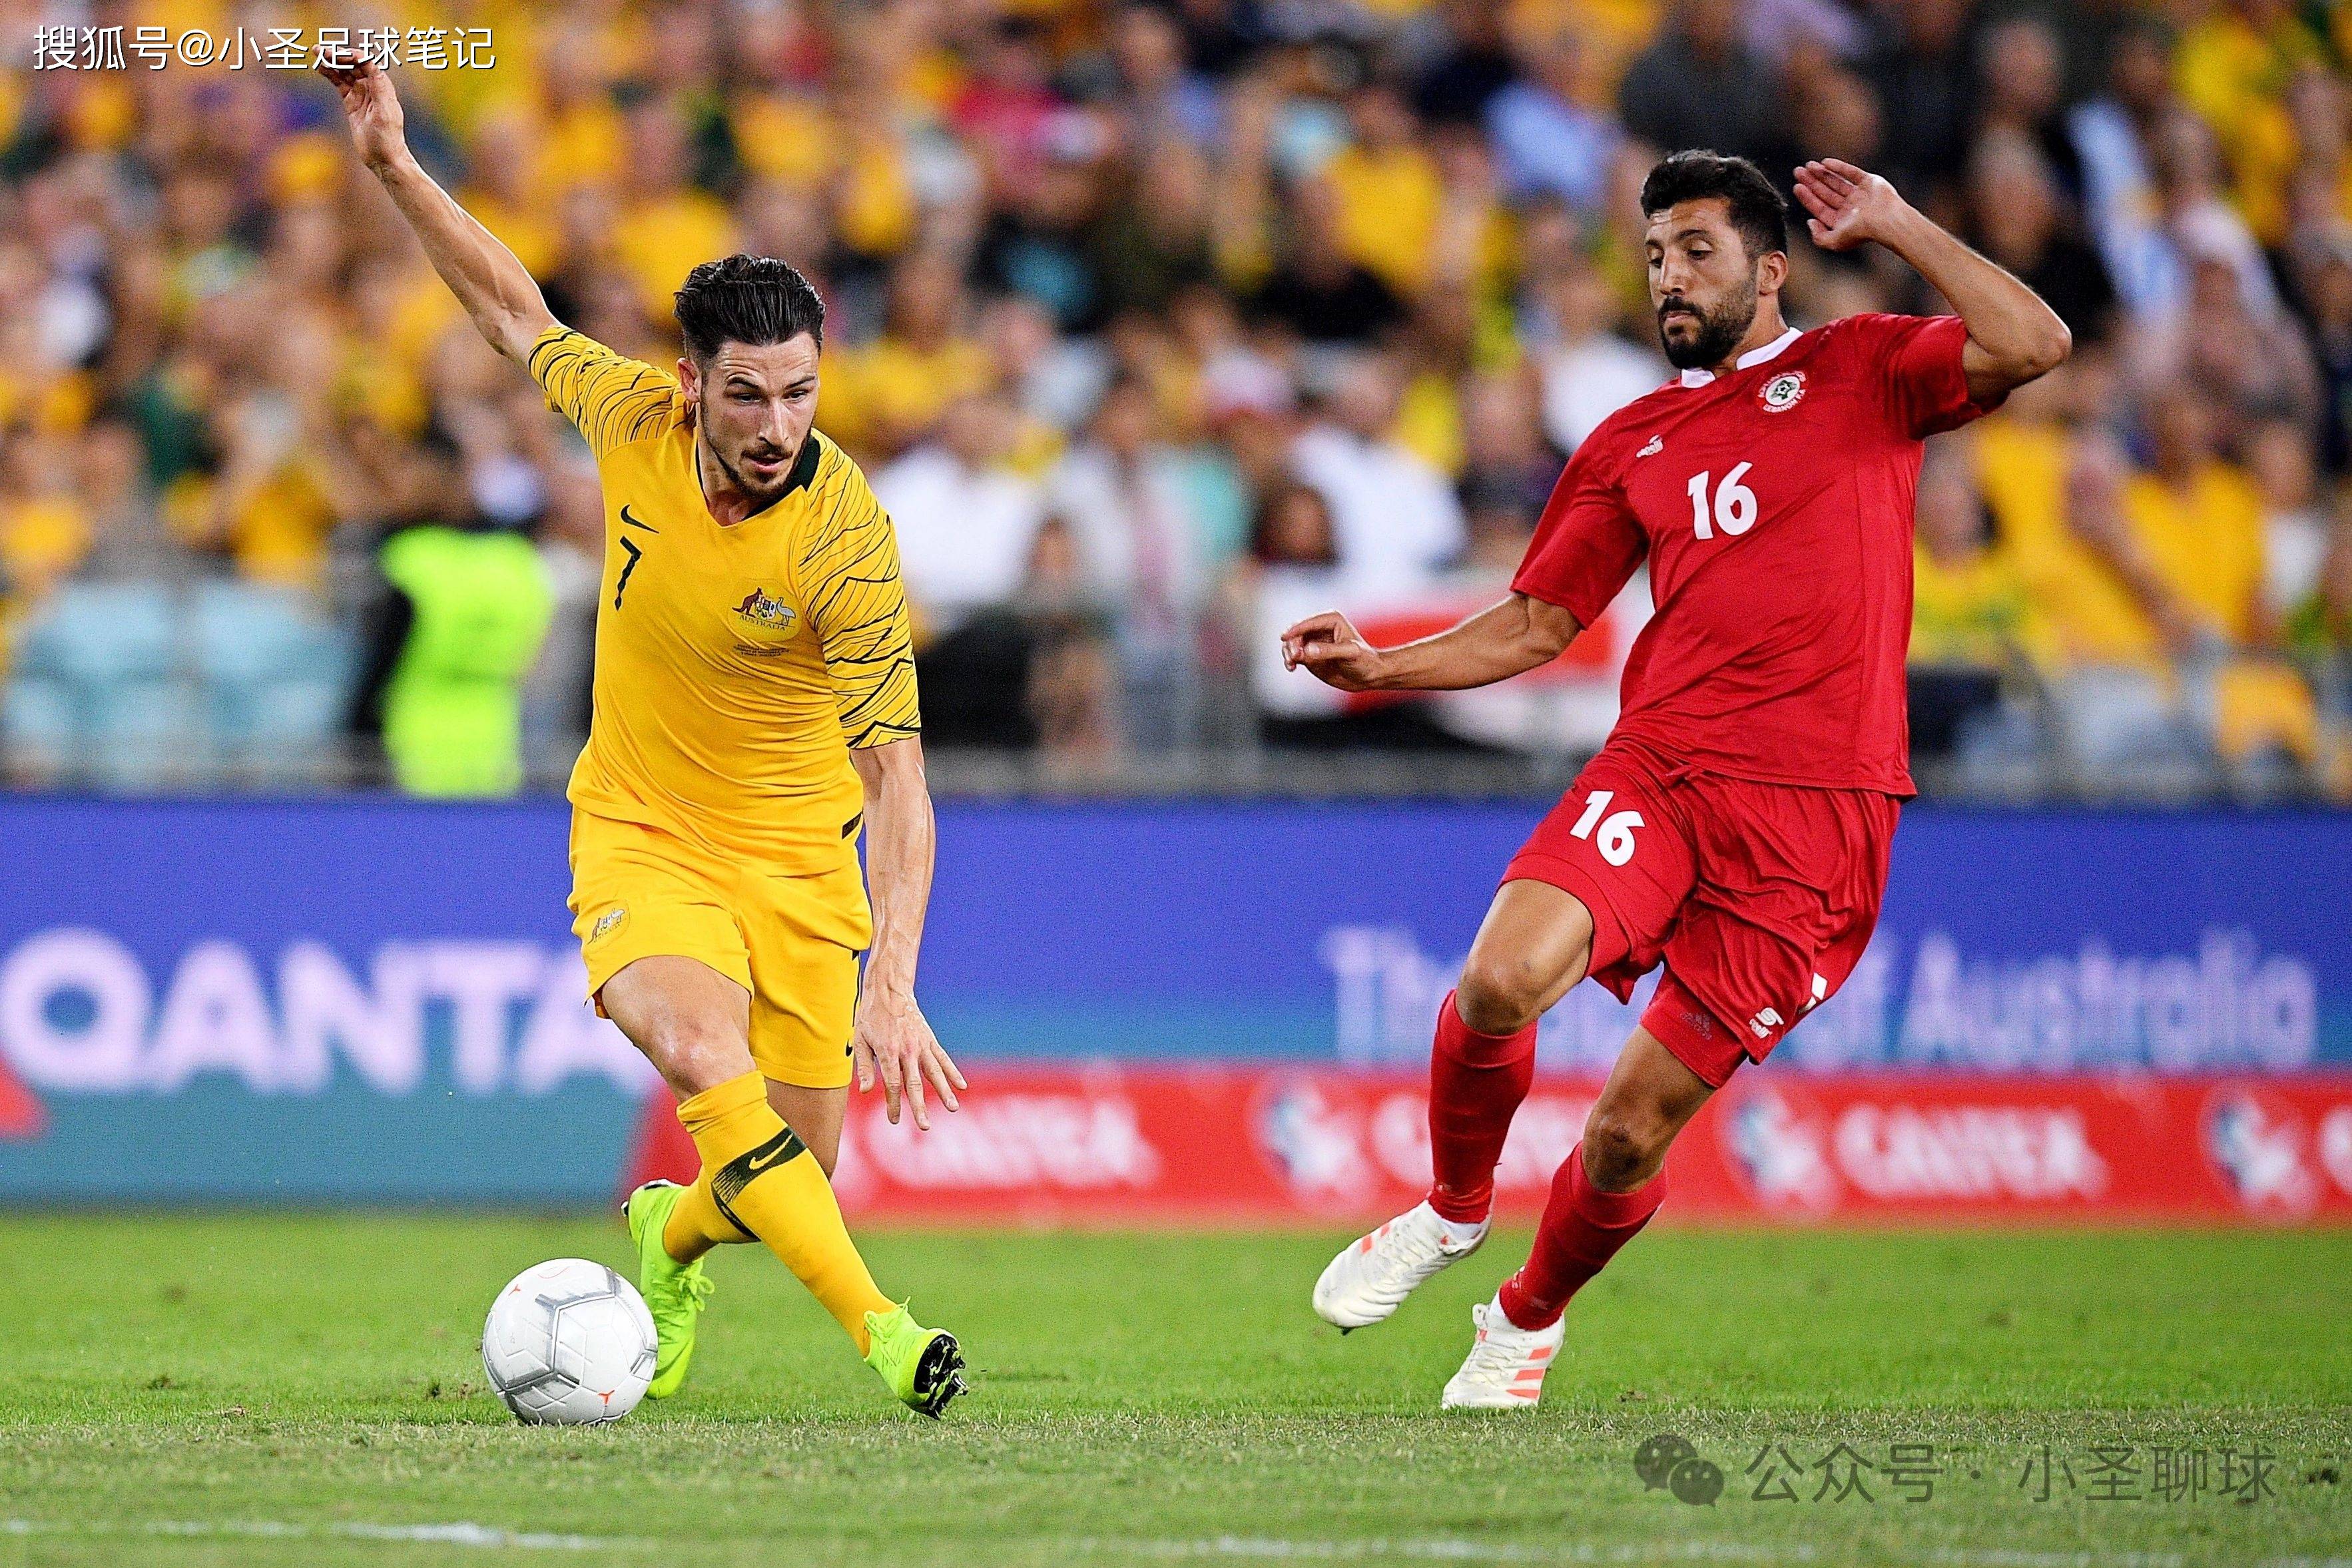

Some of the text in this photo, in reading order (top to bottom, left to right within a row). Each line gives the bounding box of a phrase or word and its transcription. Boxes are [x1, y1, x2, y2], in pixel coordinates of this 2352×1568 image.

[1687, 461, 1758, 540] 16
[615, 535, 643, 611] 7
[739, 614, 785, 631] AUSTRALIA
[1570, 790, 1645, 866] 16
[0, 929, 658, 1093] QANTA
